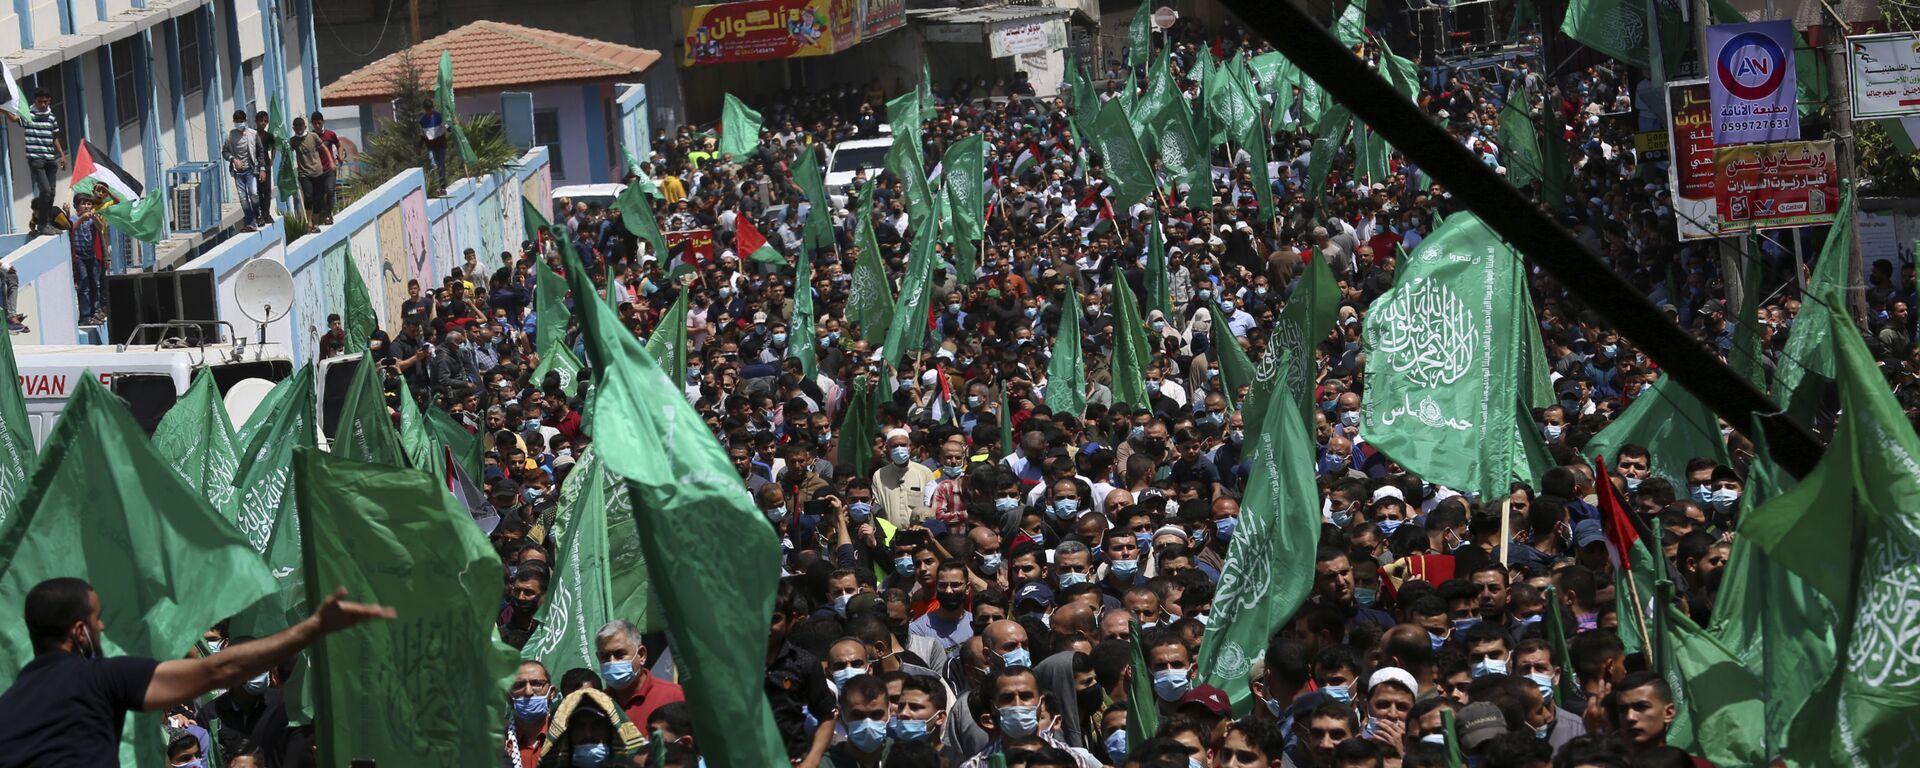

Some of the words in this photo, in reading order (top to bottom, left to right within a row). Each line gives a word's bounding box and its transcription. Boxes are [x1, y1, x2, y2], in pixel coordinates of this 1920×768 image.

[711, 6, 786, 39] ألوان
[1738, 57, 1767, 76] AN
[1683, 89, 1711, 108] از
[1721, 102, 1751, 116] الأناقة
[1753, 103, 1788, 116] مطبعة
[1721, 119, 1790, 131] 0599727631
[1726, 151, 1778, 177] يونس
[1780, 147, 1826, 168] ورشة
[1728, 178, 1770, 193] السيارات
[1771, 174, 1800, 190] زيوت
[1801, 171, 1827, 187] لغيار
[1382, 393, 1473, 431] حماس
